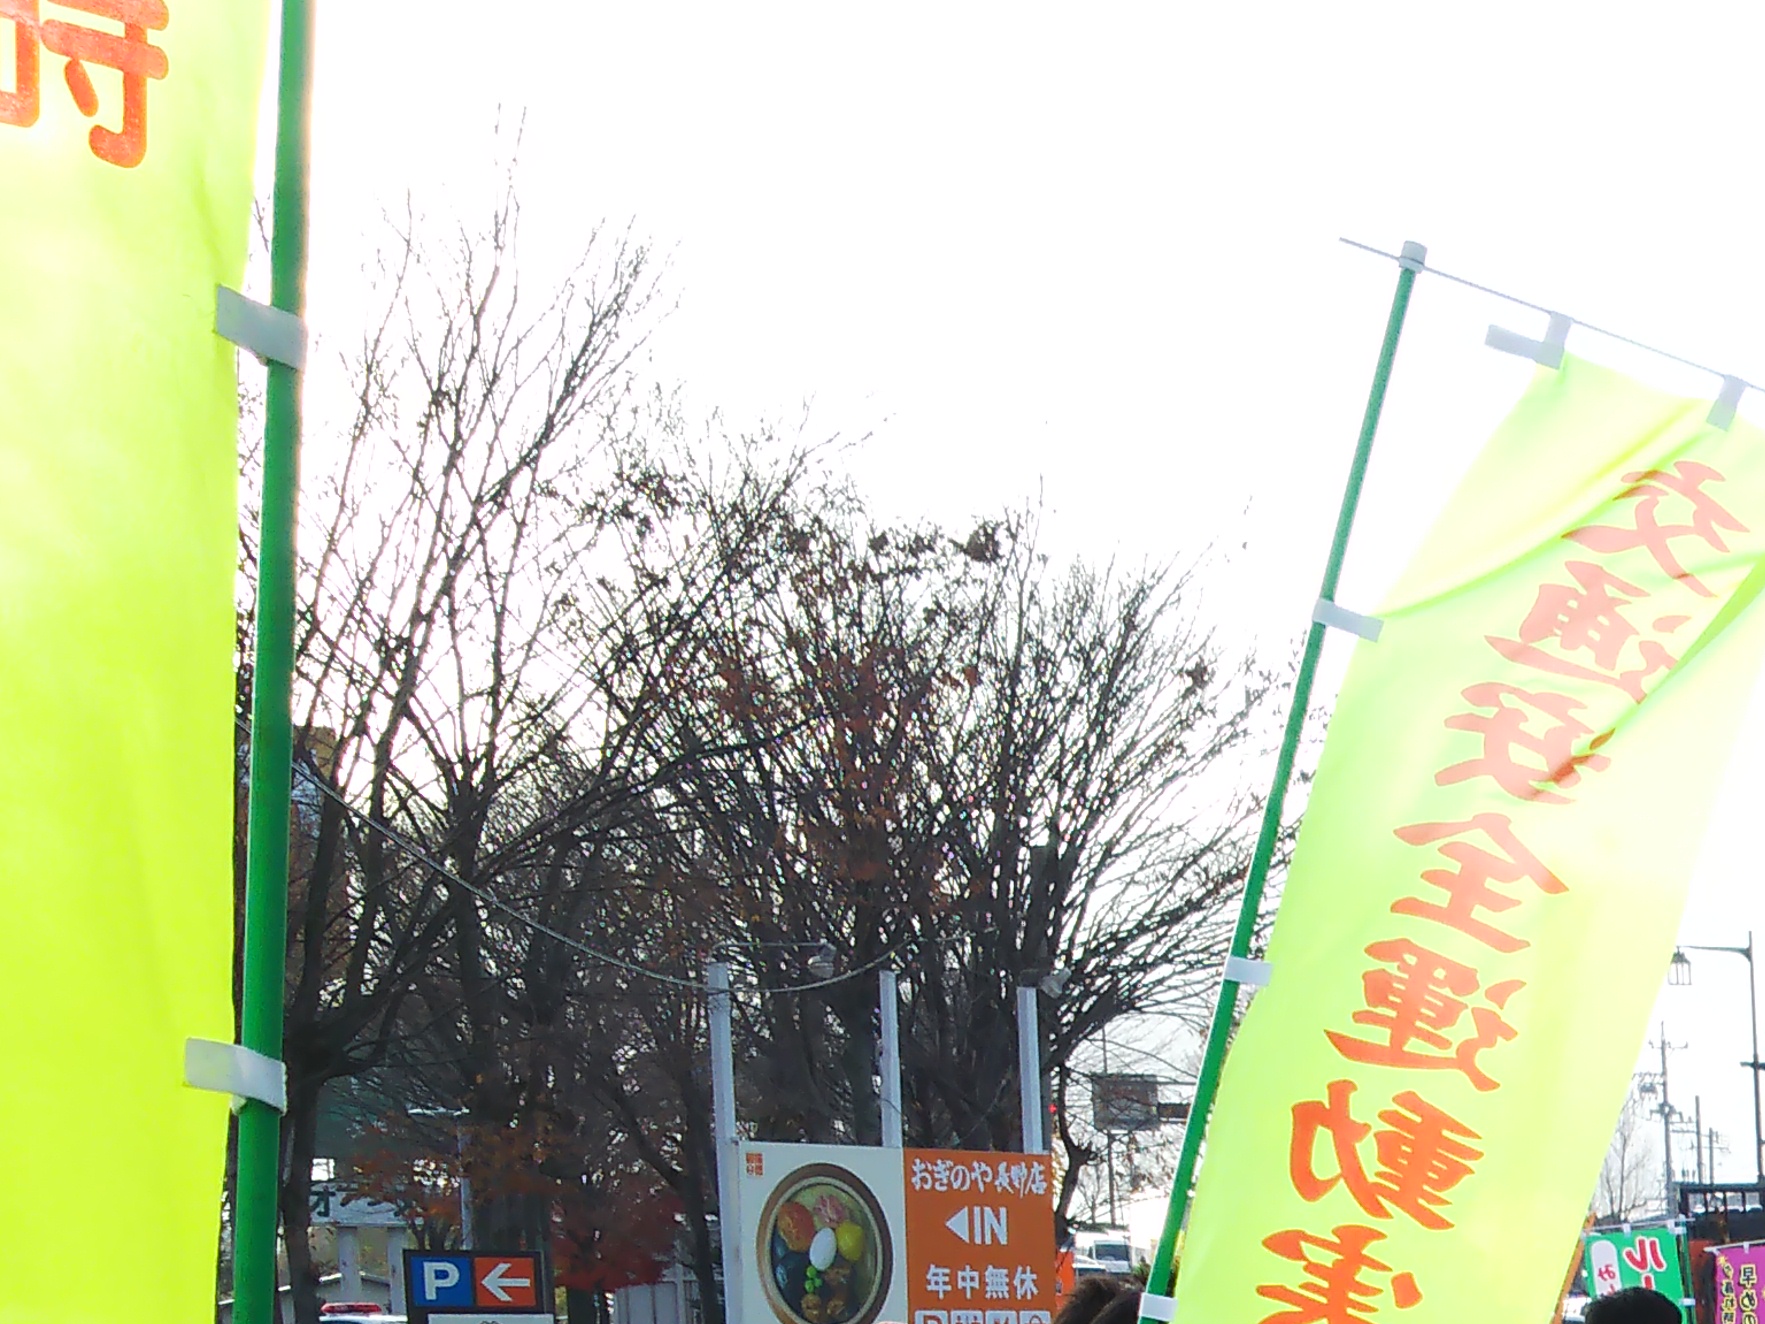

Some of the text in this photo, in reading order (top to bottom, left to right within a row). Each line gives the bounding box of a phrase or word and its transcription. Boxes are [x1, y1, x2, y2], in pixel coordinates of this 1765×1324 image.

[973, 1206, 1008, 1245] IN
[423, 1261, 460, 1301] P
[926, 1264, 1039, 1300] 年中無休
